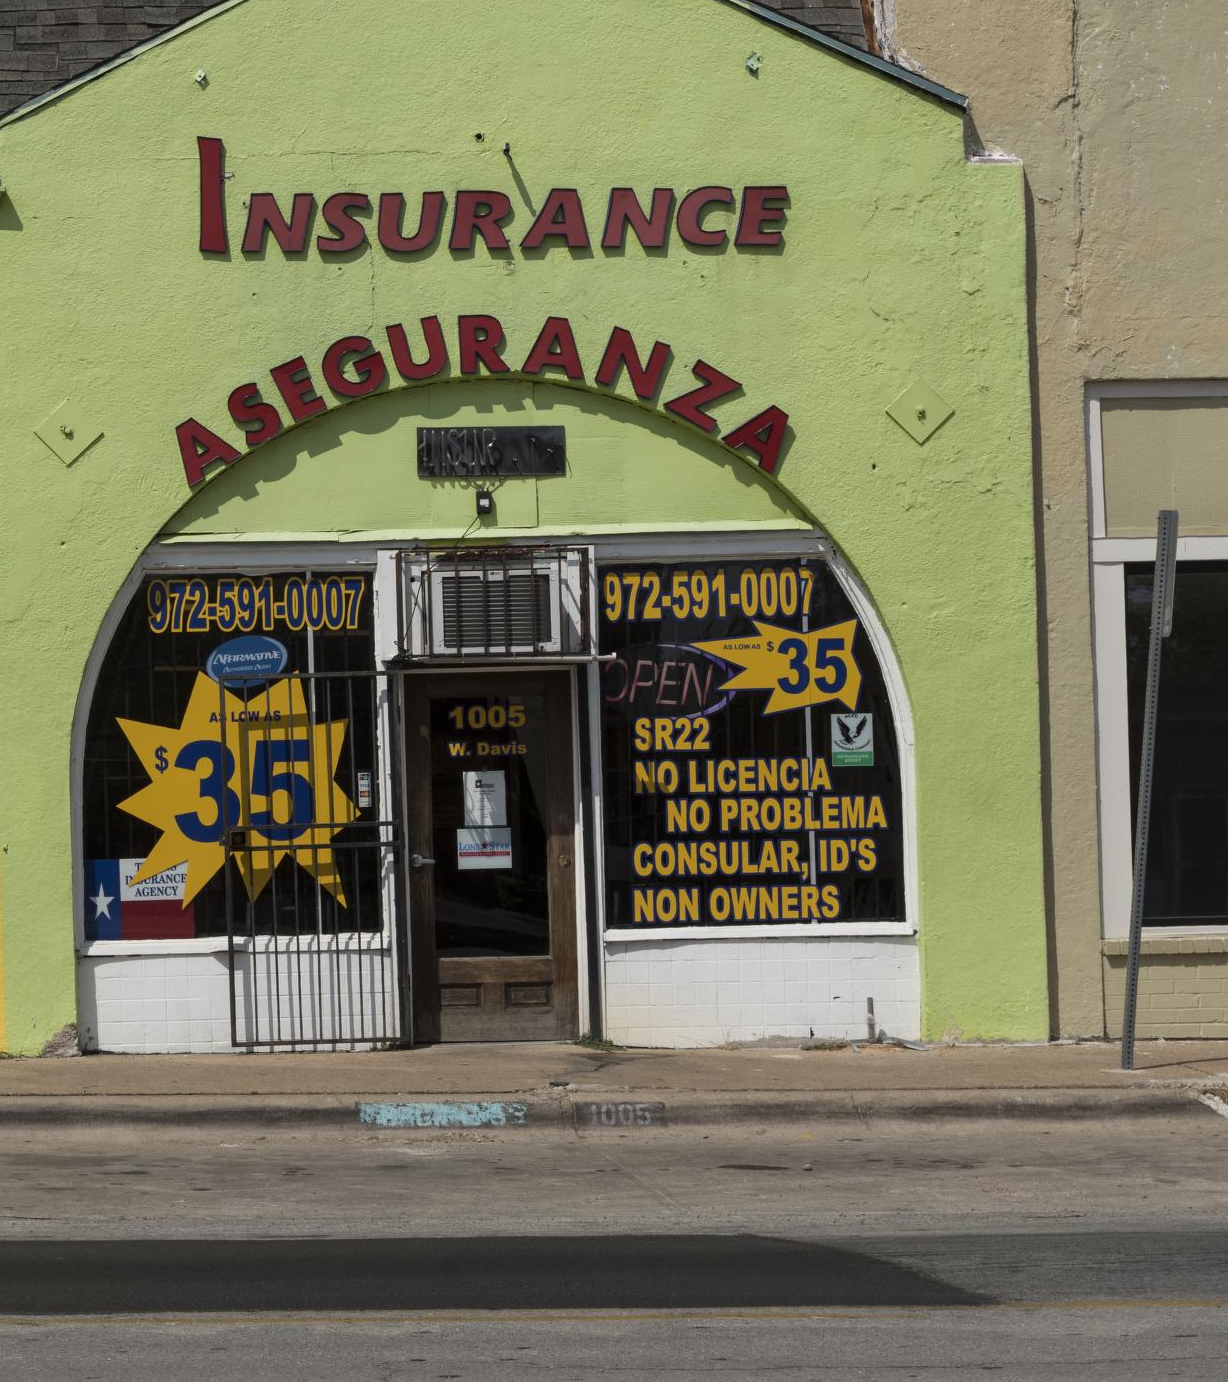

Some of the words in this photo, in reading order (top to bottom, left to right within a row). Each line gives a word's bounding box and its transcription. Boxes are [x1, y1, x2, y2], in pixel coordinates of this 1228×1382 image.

[197, 136, 789, 254] INSURANCE
[174, 314, 790, 489] ASEGURANZA
[147, 576, 365, 634] 972-591-0007
[604, 566, 814, 622] 972-591-0007
[213, 650, 282, 665] AFFIRMATIVE
[605, 658, 714, 707] OPEN
[448, 705, 527, 730] 1005
[633, 717, 711, 752] SR22
[448, 742, 471, 757] W.
[476, 741, 528, 756] Davis
[634, 760, 680, 795] NO
[688, 757, 832, 794] LICENCIA
[666, 799, 710, 834] NO
[720, 795, 888, 831] PROBLEMA
[633, 840, 810, 880] CONSULAR,
[818, 837, 878, 873] ID'S
[135, 885, 179, 897] AGENCY
[633, 887, 701, 923] NON
[709, 885, 841, 920] OWNERS
[589, 1103, 652, 1126] 1005
